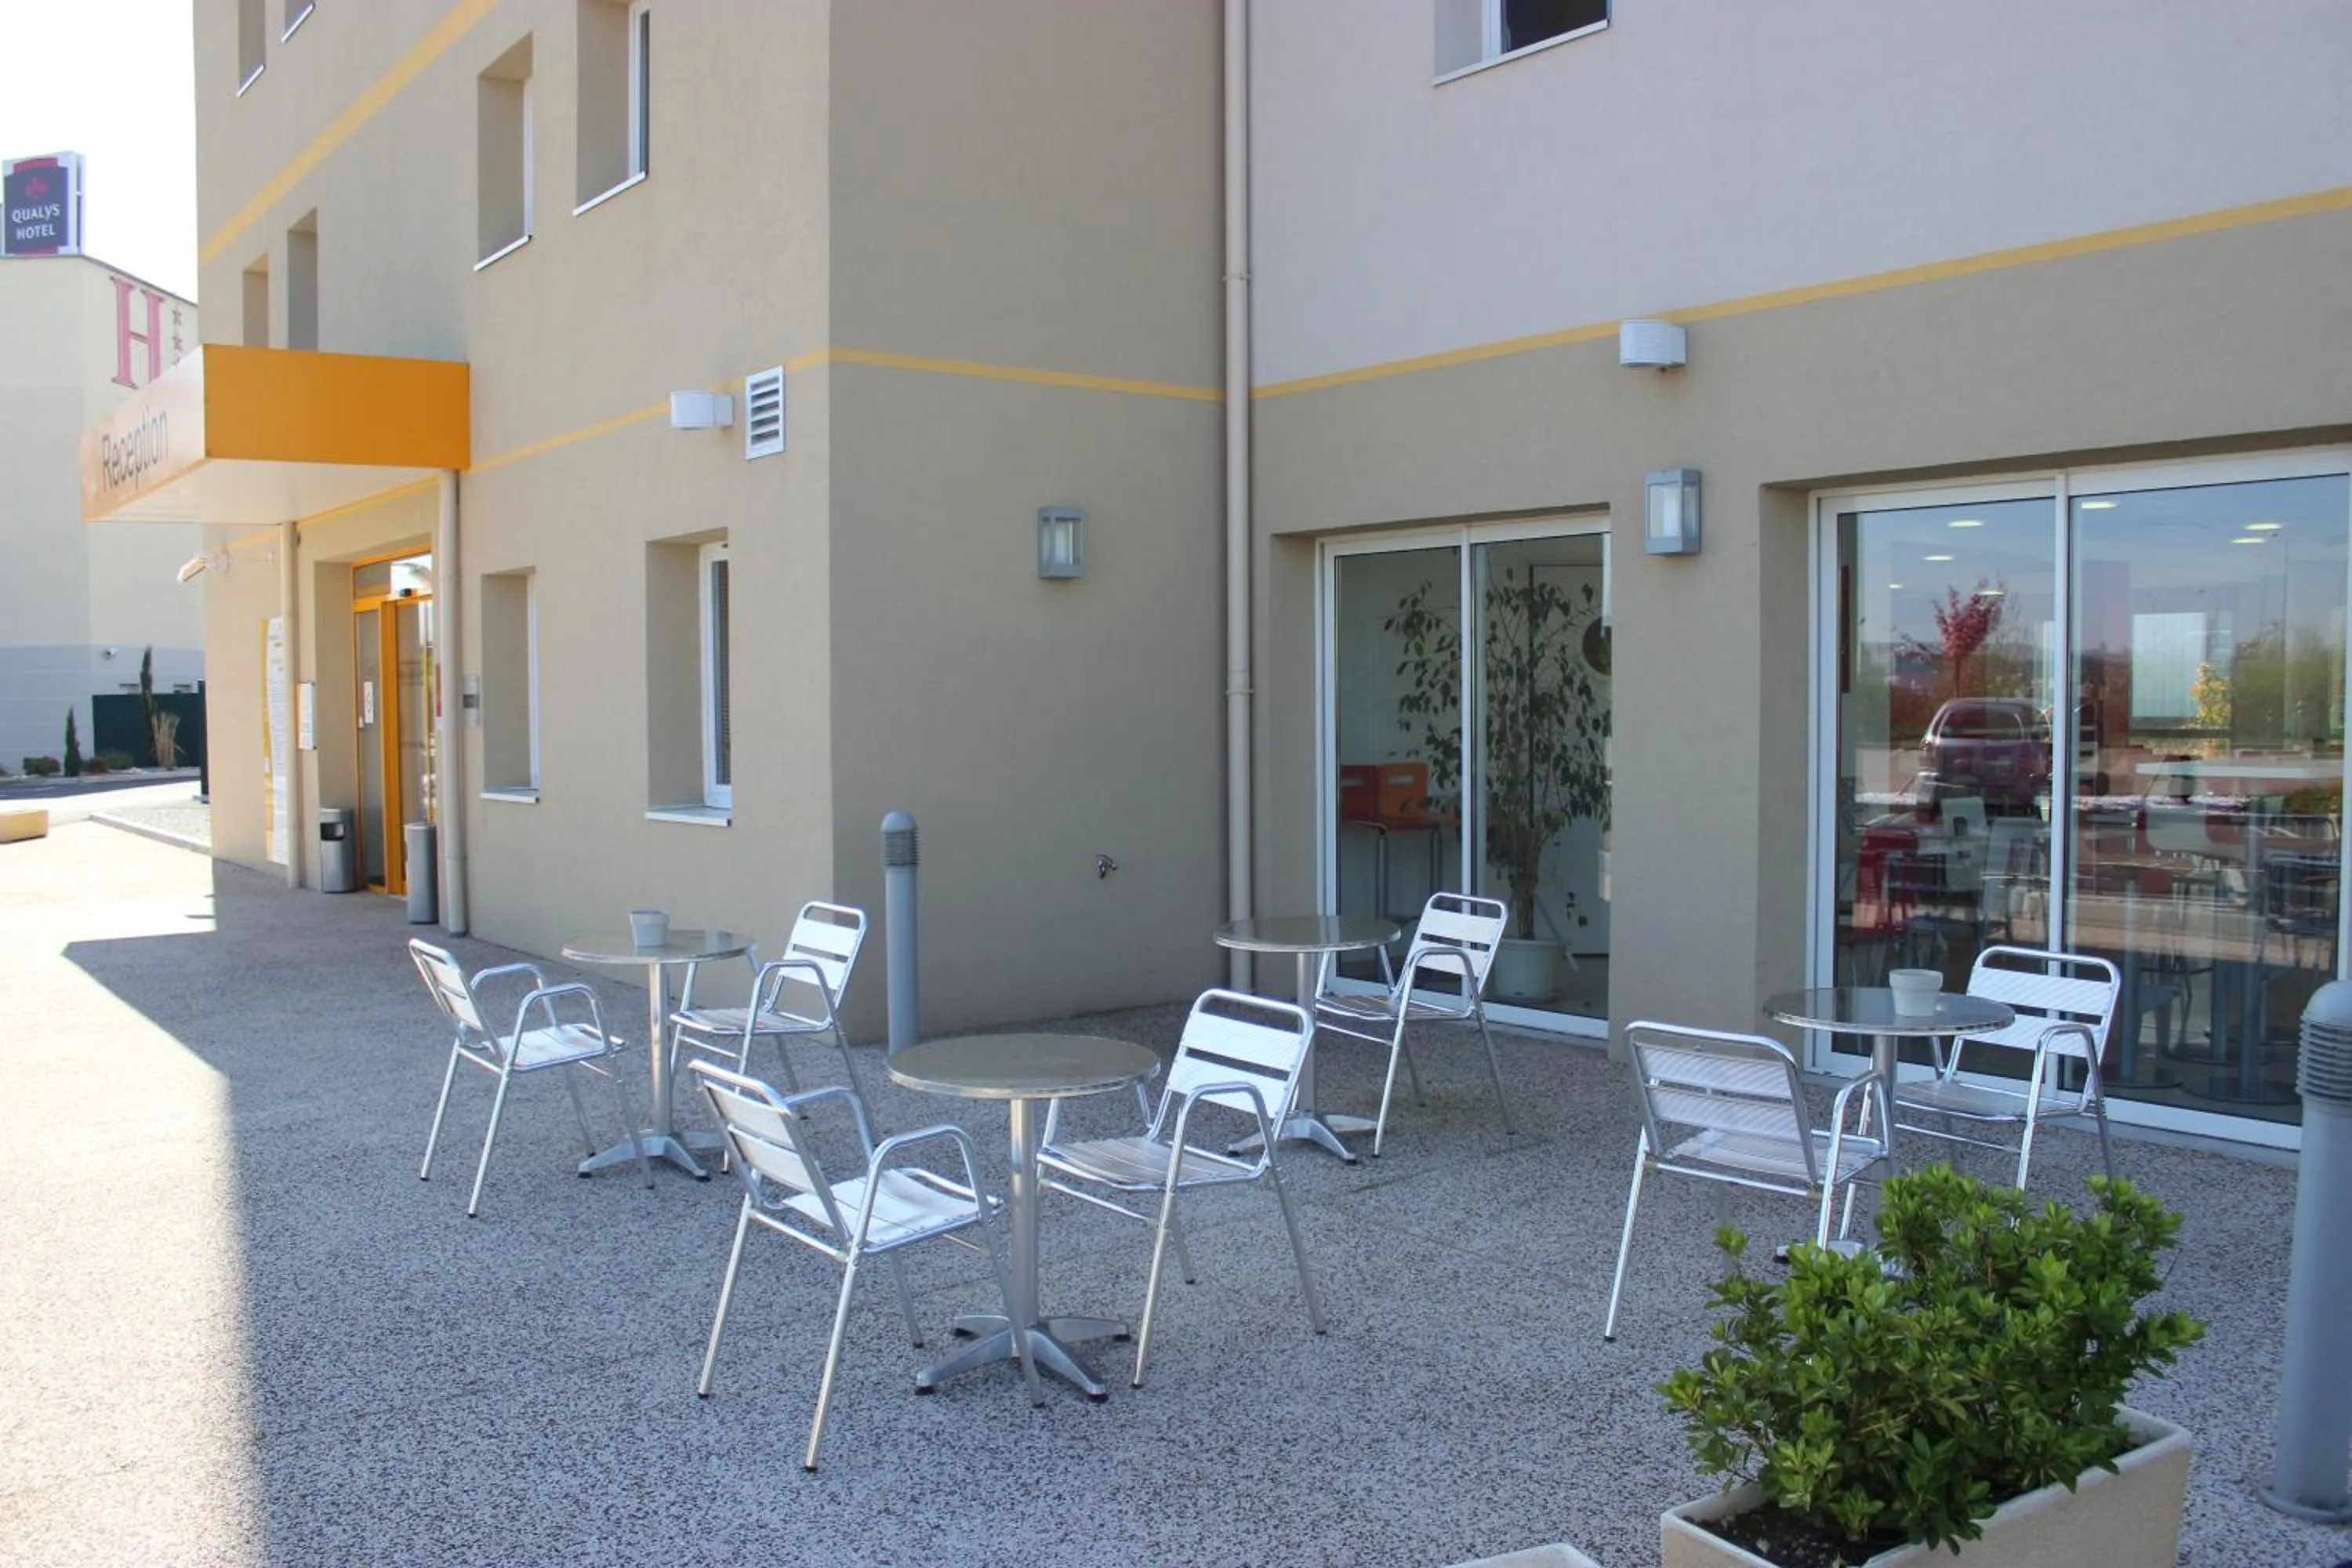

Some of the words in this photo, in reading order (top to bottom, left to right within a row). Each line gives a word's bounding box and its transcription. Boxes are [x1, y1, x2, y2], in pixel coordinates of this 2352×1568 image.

[16, 223, 56, 239] HOTEL
[109, 276, 165, 390] H
[101, 405, 169, 492] Reception
